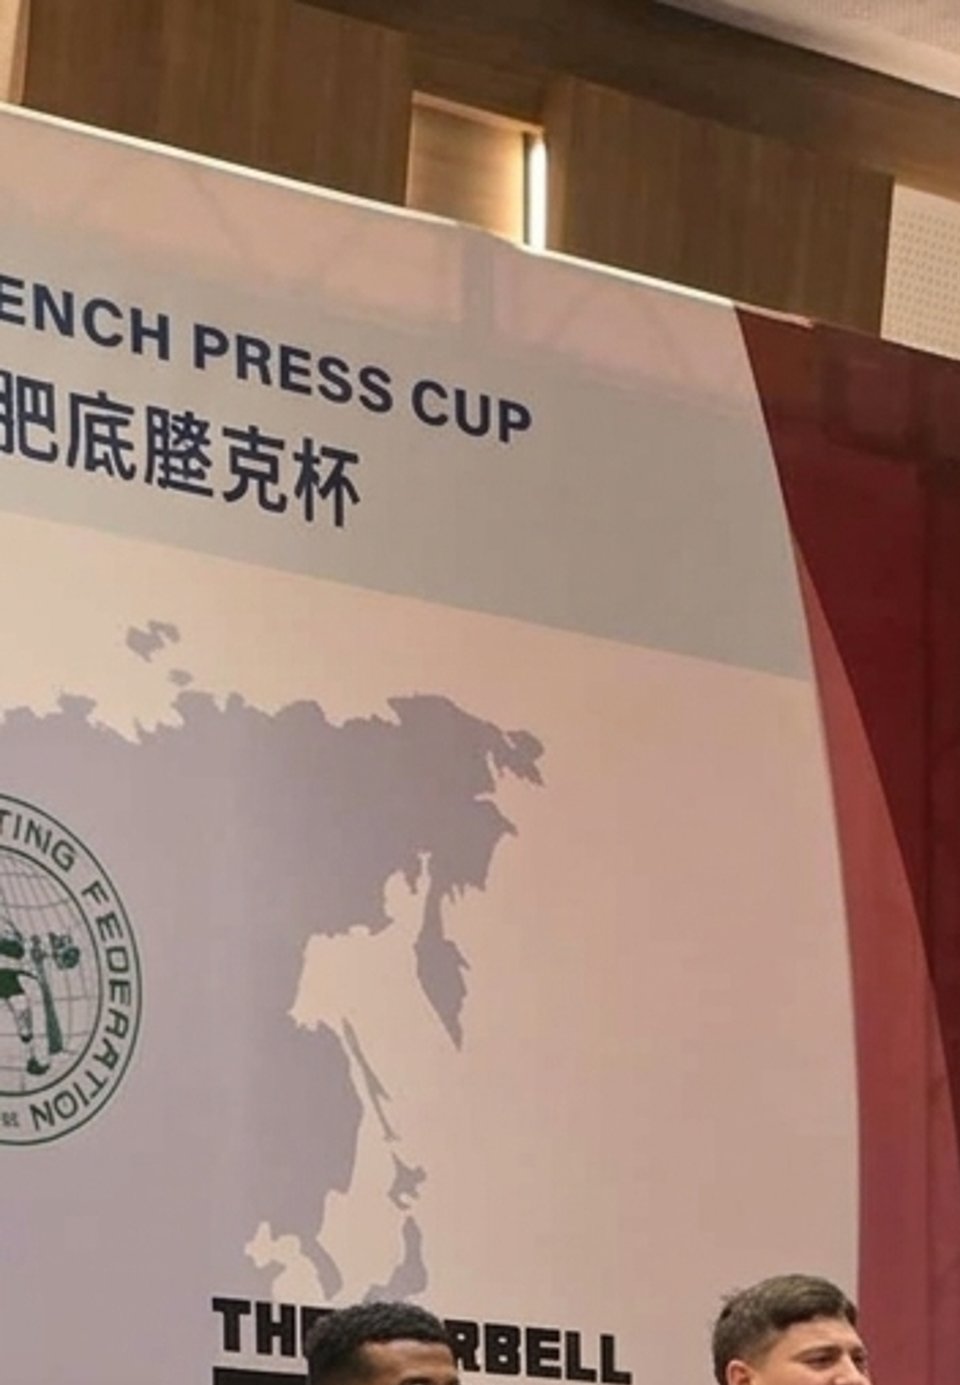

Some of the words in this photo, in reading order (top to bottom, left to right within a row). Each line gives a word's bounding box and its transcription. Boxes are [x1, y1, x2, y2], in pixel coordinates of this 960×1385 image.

[193, 323, 394, 413] PRESS
[410, 379, 532, 443] CUP
[30, 880, 132, 1131] FEDERATION
[443, 1319, 632, 1385] RBELL
